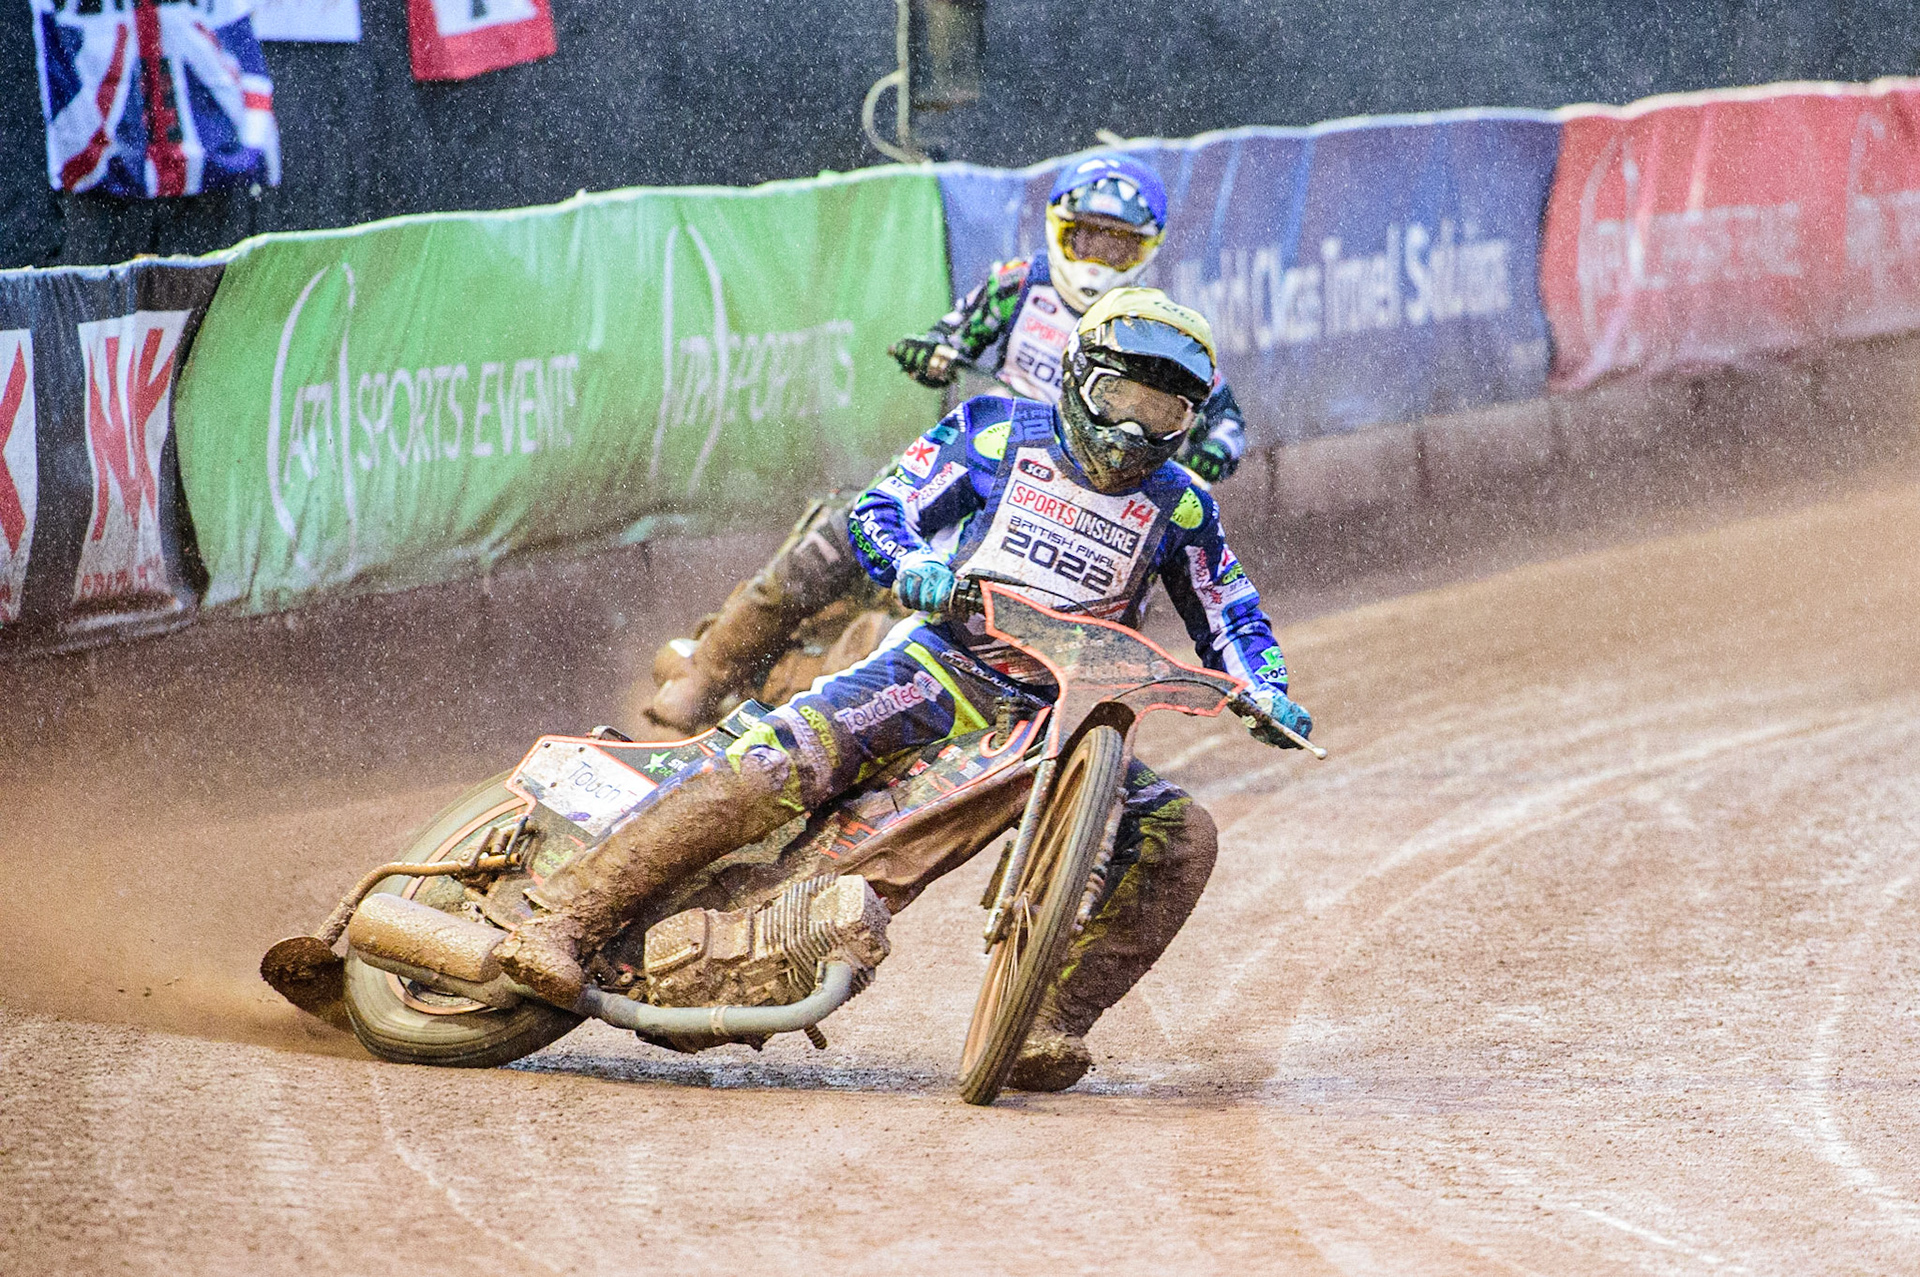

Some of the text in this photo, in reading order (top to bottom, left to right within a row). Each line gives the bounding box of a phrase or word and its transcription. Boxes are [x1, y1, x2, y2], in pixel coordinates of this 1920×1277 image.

[356, 363, 468, 471] SPORTS
[1025, 463, 1051, 480] SCB
[1009, 515, 1118, 571] BRITISH FINAL
[1012, 485, 1138, 555] SPORTS INSURE
[1120, 499, 1155, 527] 14
[1000, 529, 1114, 596] 2022
